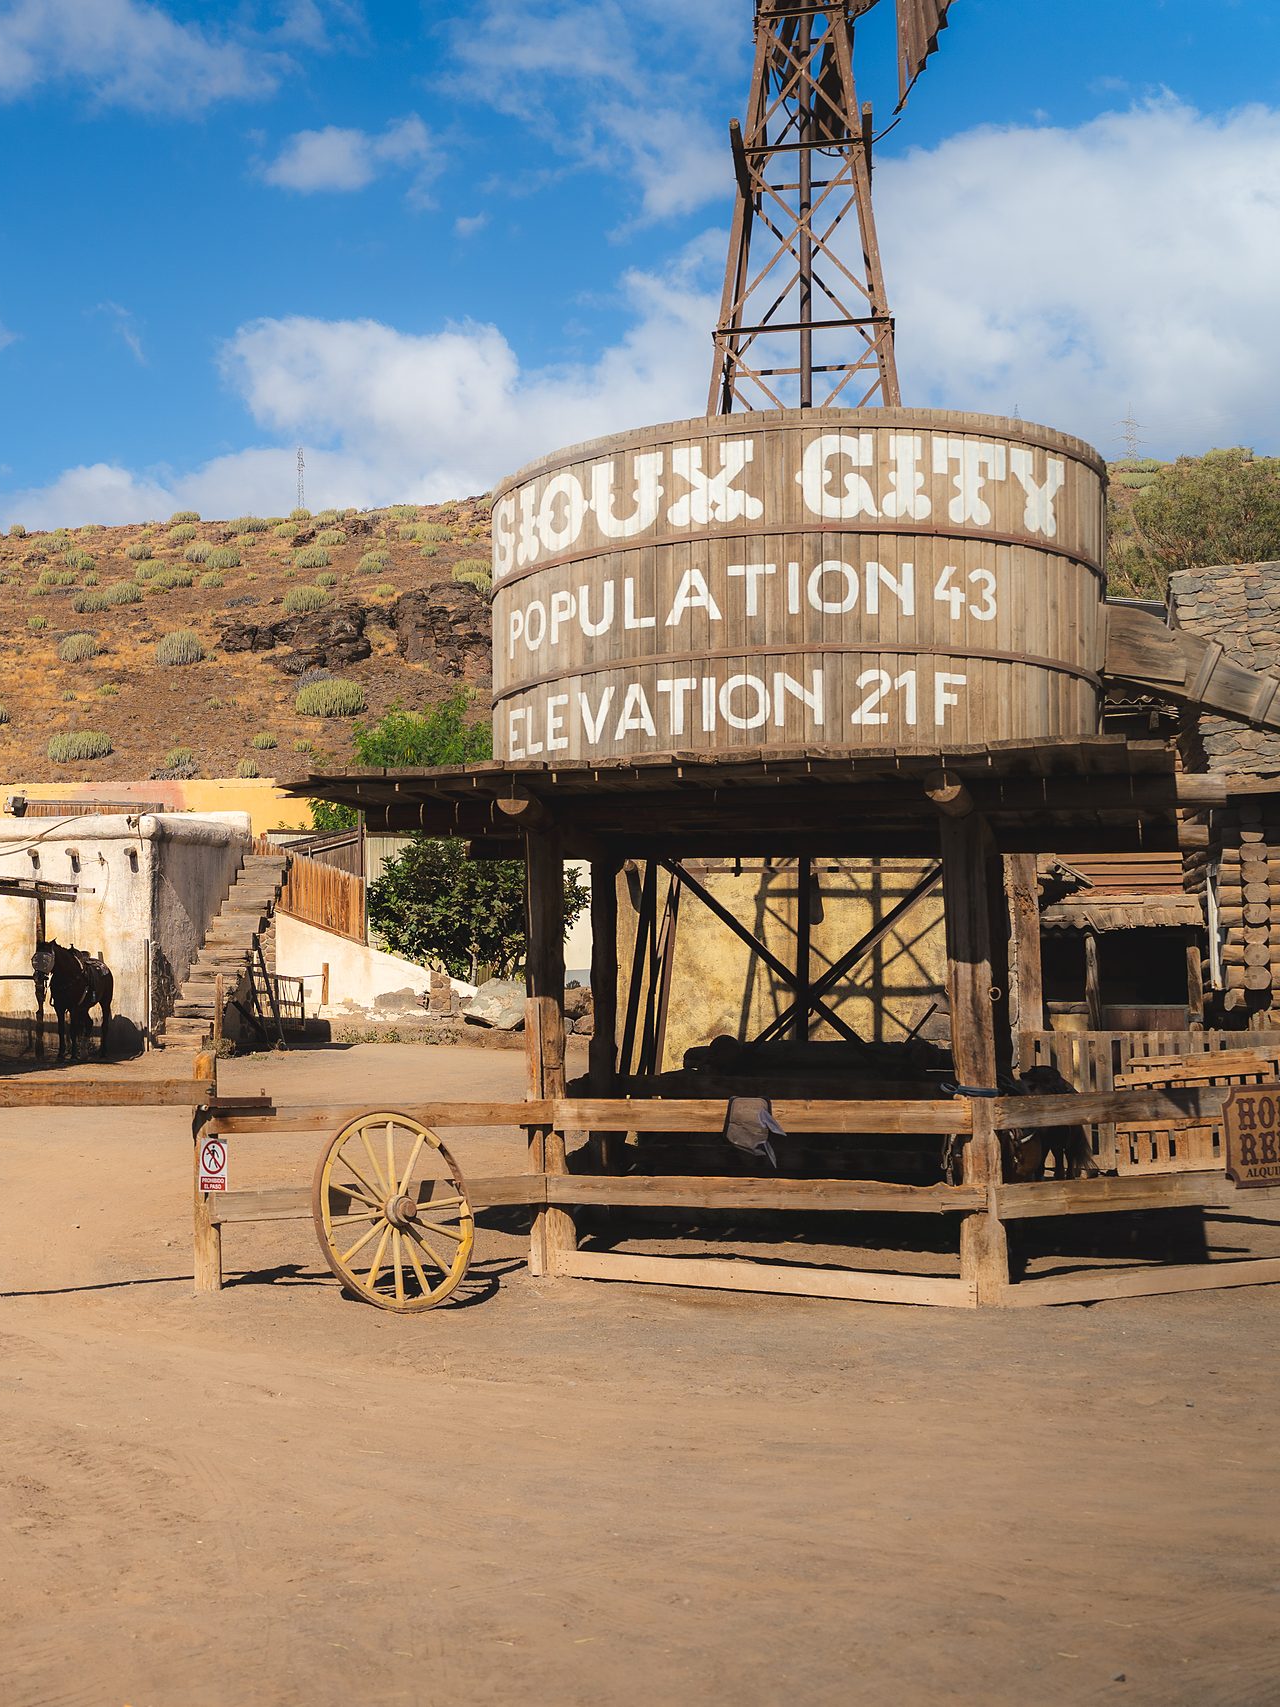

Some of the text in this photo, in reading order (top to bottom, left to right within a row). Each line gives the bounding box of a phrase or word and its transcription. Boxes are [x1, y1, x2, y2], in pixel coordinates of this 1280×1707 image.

[494, 434, 1065, 578] SIOUX CITY
[509, 560, 997, 660] POPULATION 43
[508, 669, 824, 761] ELEVATION
[1236, 1096, 1280, 1130] HO
[1240, 1131, 1280, 1165] RE
[1246, 1166, 1280, 1178] ALQUI
